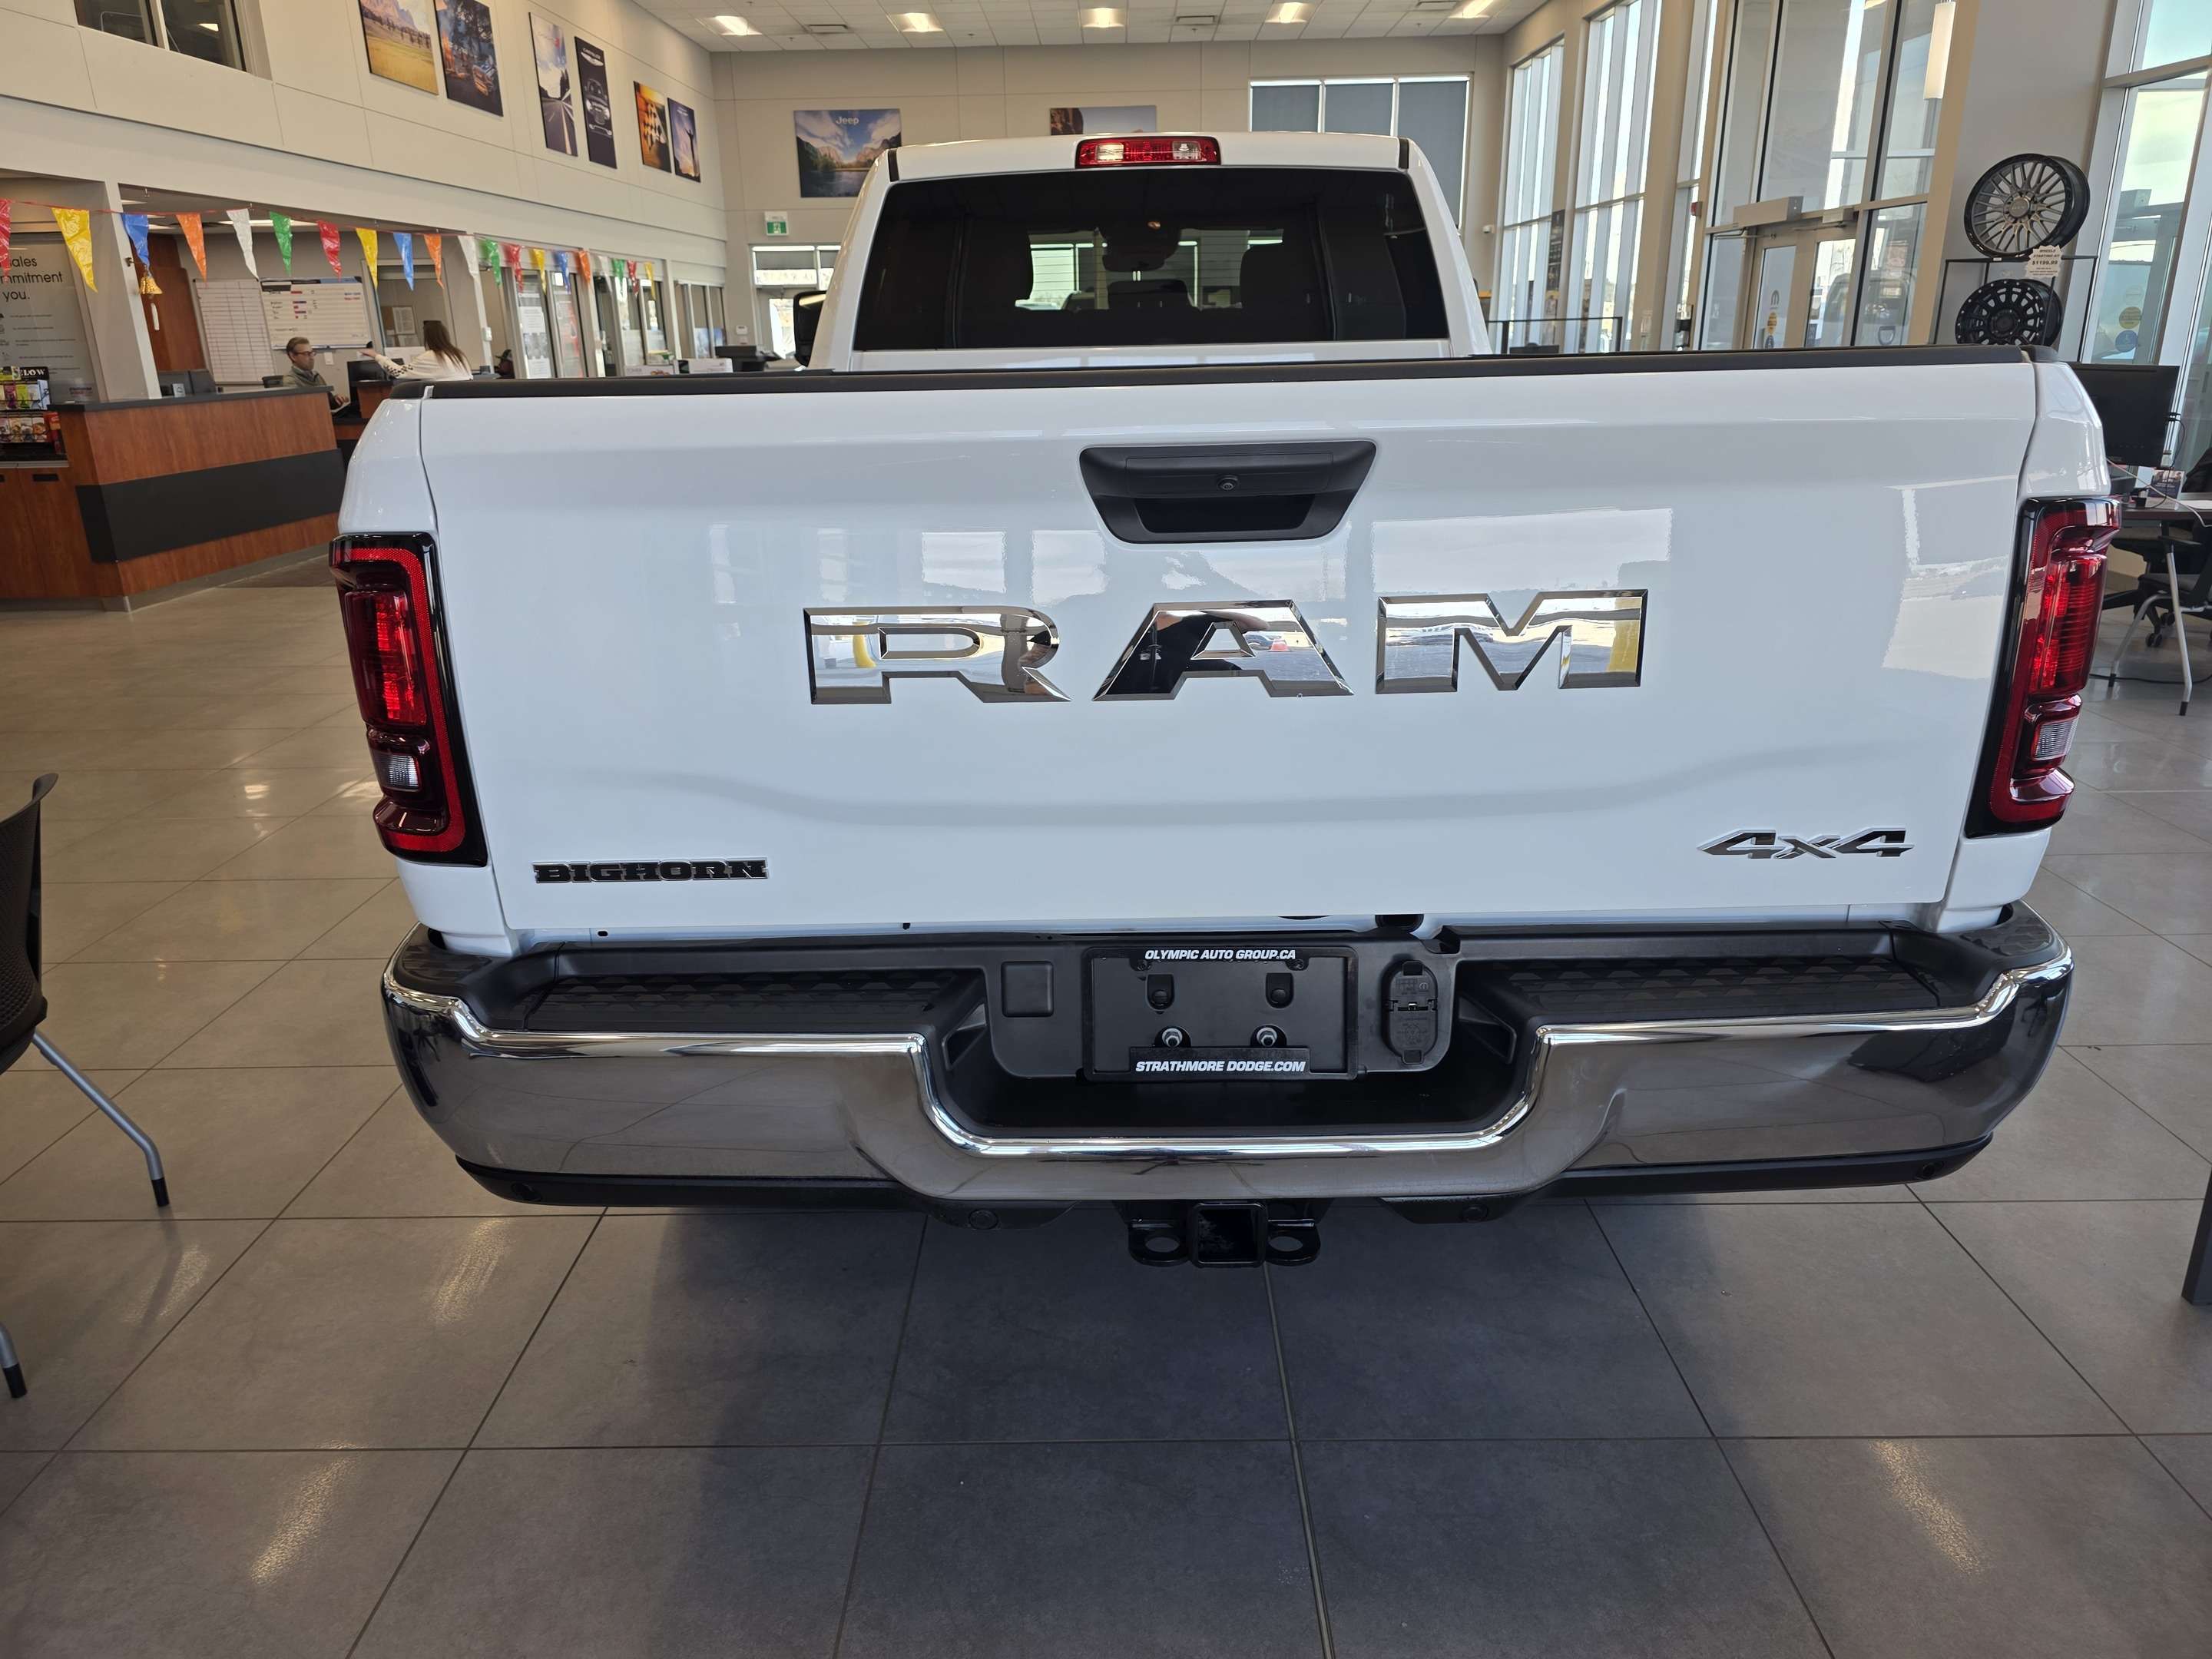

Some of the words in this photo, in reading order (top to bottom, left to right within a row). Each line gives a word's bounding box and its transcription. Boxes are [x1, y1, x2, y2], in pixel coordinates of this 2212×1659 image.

[835, 116, 859, 126] Jeep
[2, 291, 30, 303] you.
[803, 588, 1648, 705] RAM
[534, 857, 769, 883] BIGHORN
[1145, 950, 1200, 959] OLYMPIC
[1200, 950, 1233, 959] AUTO
[1235, 949, 1296, 959] GROUP.CA
[1136, 1061, 1226, 1071] STRATHMORE
[1227, 1061, 1306, 1071] DODGE.COM
